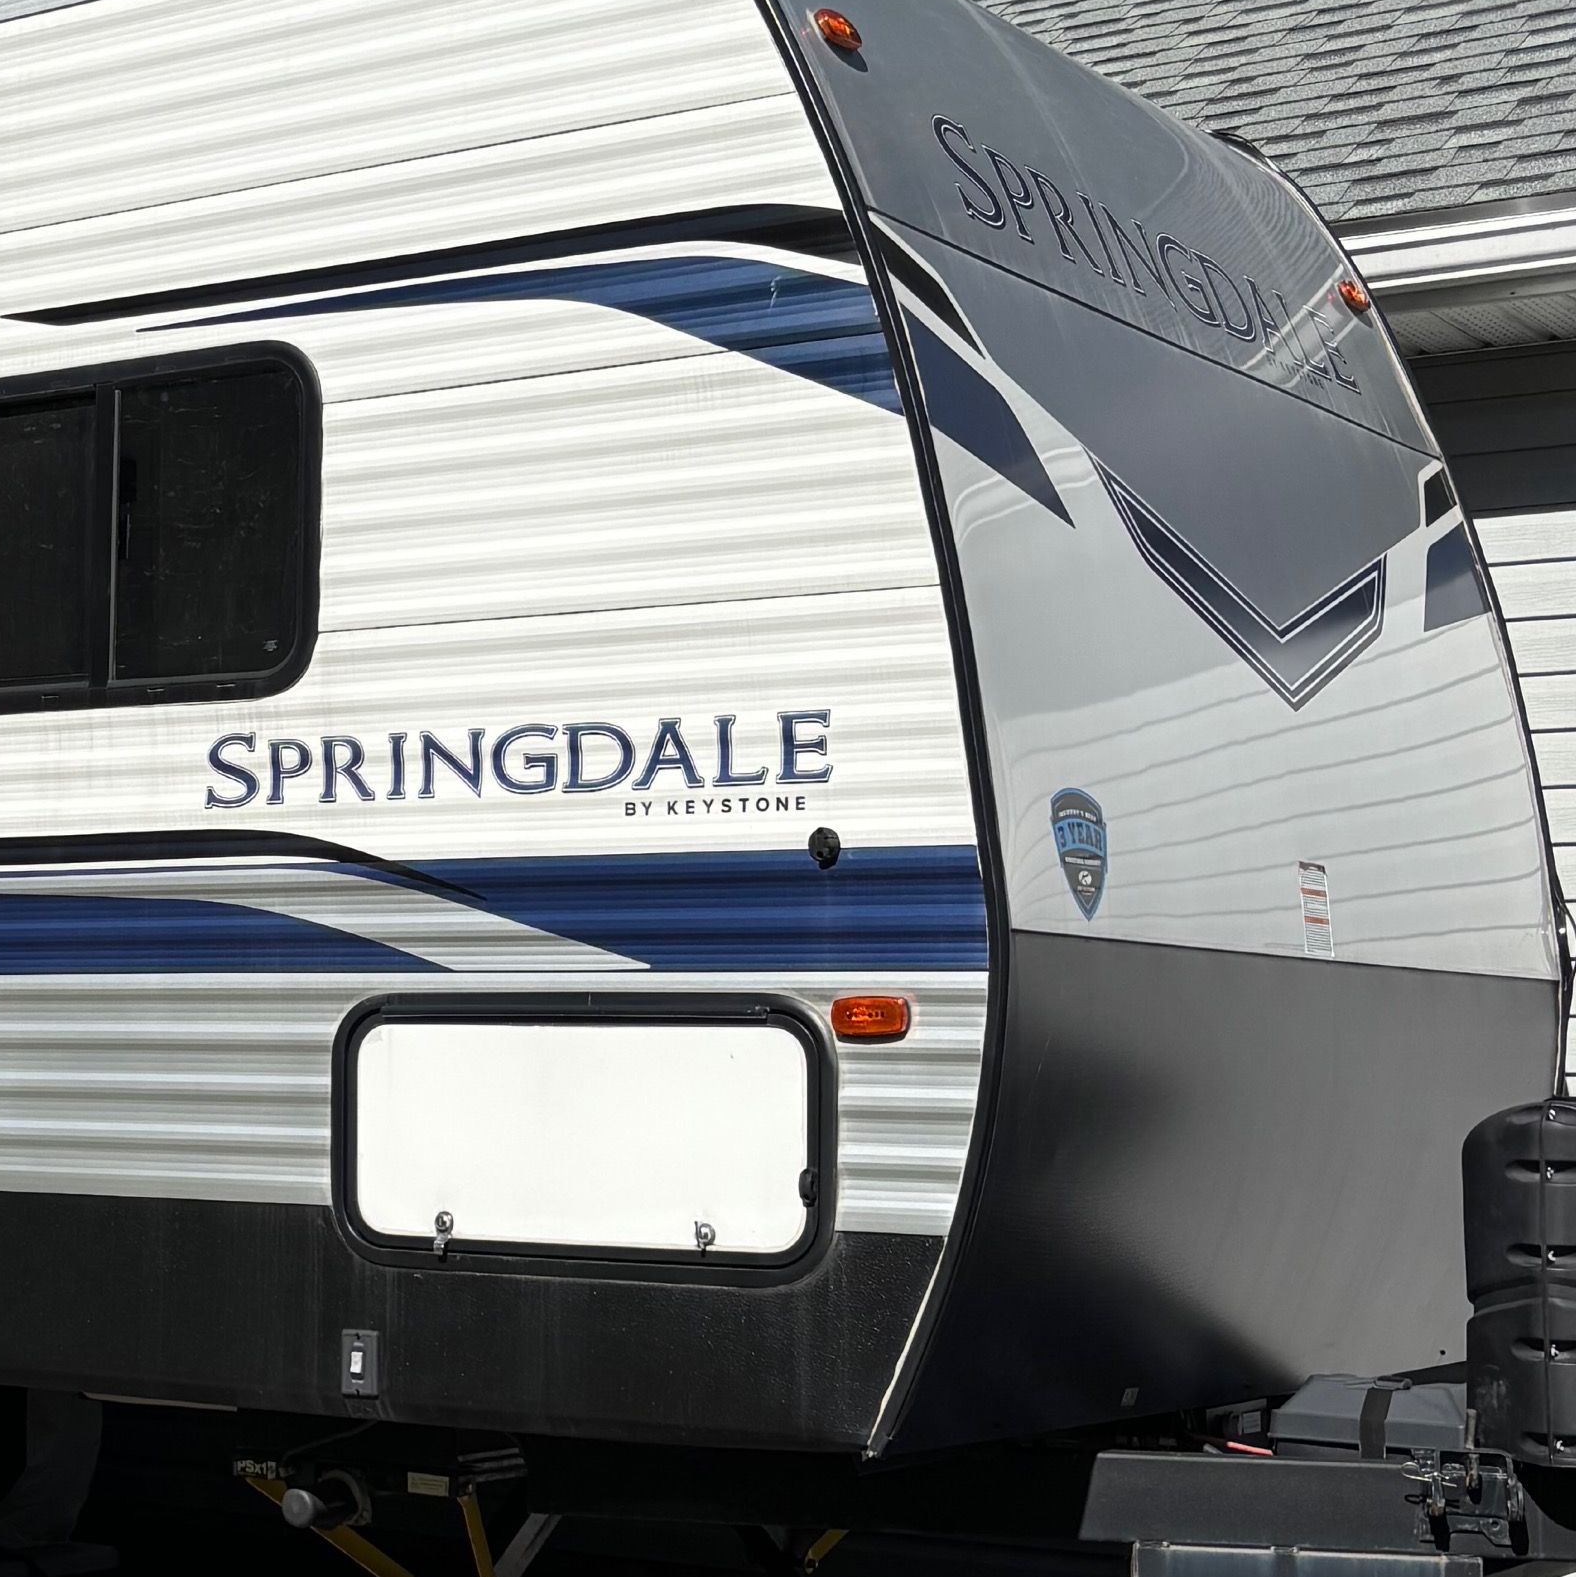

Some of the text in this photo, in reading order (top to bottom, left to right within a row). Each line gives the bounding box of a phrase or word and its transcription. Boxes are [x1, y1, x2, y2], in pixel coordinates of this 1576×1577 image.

[932, 115, 1361, 394] SPRINGDALE
[205, 709, 833, 809] SPRINGDALE
[625, 796, 806, 816] BY KEYSTONE
[1057, 822, 1102, 852] 3 YEAR
